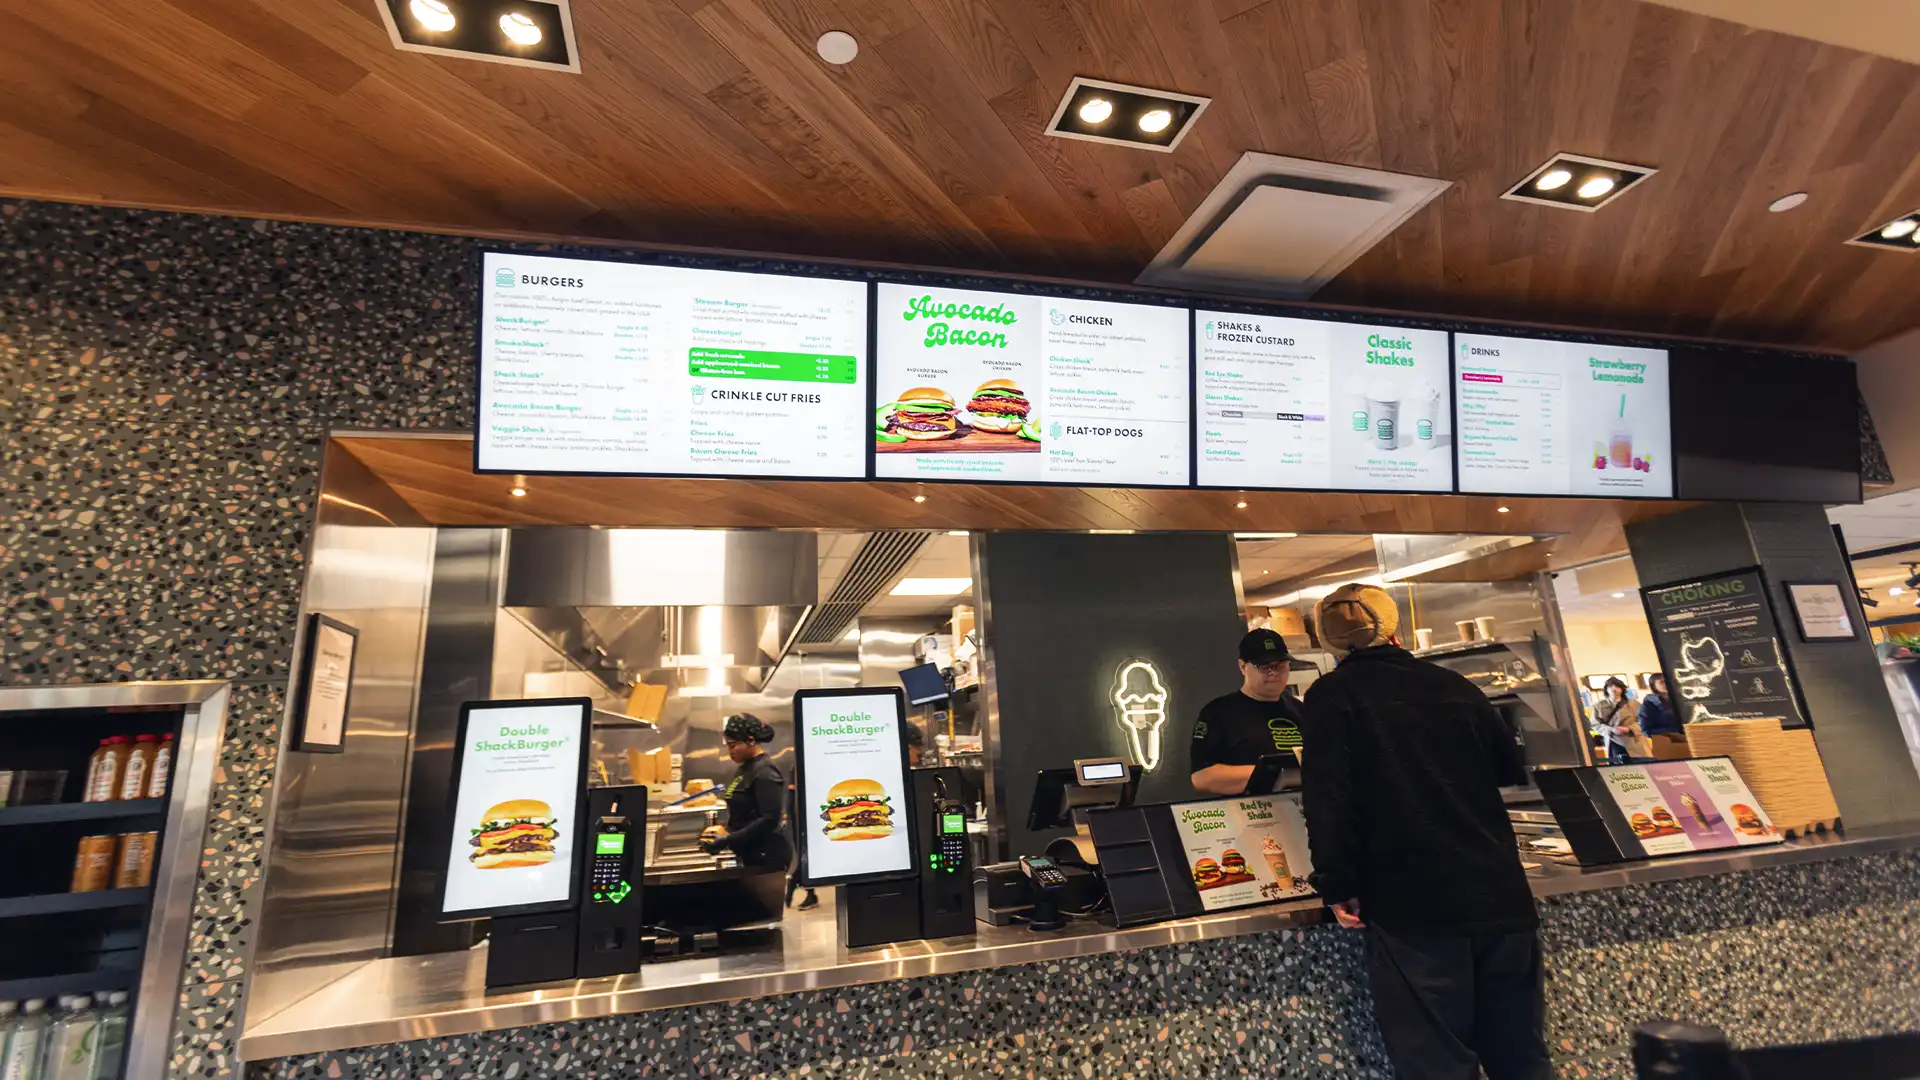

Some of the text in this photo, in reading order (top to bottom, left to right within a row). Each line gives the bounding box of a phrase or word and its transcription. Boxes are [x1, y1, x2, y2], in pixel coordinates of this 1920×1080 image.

[521, 275, 584, 288] BURGERS
[724, 299, 749, 309] Burger
[903, 295, 1018, 325] Avocado
[1068, 315, 1113, 326] CHICKEN
[1217, 321, 1262, 332] SHAKES &
[692, 327, 742, 337] Cheeseburger
[924, 322, 1008, 348] Bacon
[1217, 332, 1295, 346] FROZEN CUSTARD
[1367, 334, 1412, 351] Classic
[1471, 347, 1500, 357] DRINKS
[1366, 351, 1415, 367] Shakes
[1589, 357, 1646, 374] Strawberry
[1593, 369, 1644, 383] Lemonade
[711, 390, 821, 404] CRINKLE CUT FRIES
[492, 401, 582, 413] Avocado Bacon Burger
[492, 425, 520, 433] Veggie
[1066, 426, 1143, 438] FLAT-TOP DOGS
[690, 447, 713, 455] Bacon
[714, 448, 740, 456] Cheese
[1662, 580, 1745, 605] CHOKING
[830, 712, 872, 722] Double
[500, 724, 549, 737] Double
[1698, 763, 1727, 775] Veggie
[1609, 772, 1646, 784] Avocado
[1708, 773, 1732, 782] Shack
[1621, 782, 1649, 794] Bacon
[1240, 801, 1273, 812] Red Eye
[1182, 808, 1226, 823] Avocado
[1247, 812, 1273, 821] Shake
[1193, 820, 1226, 834] Bacon
